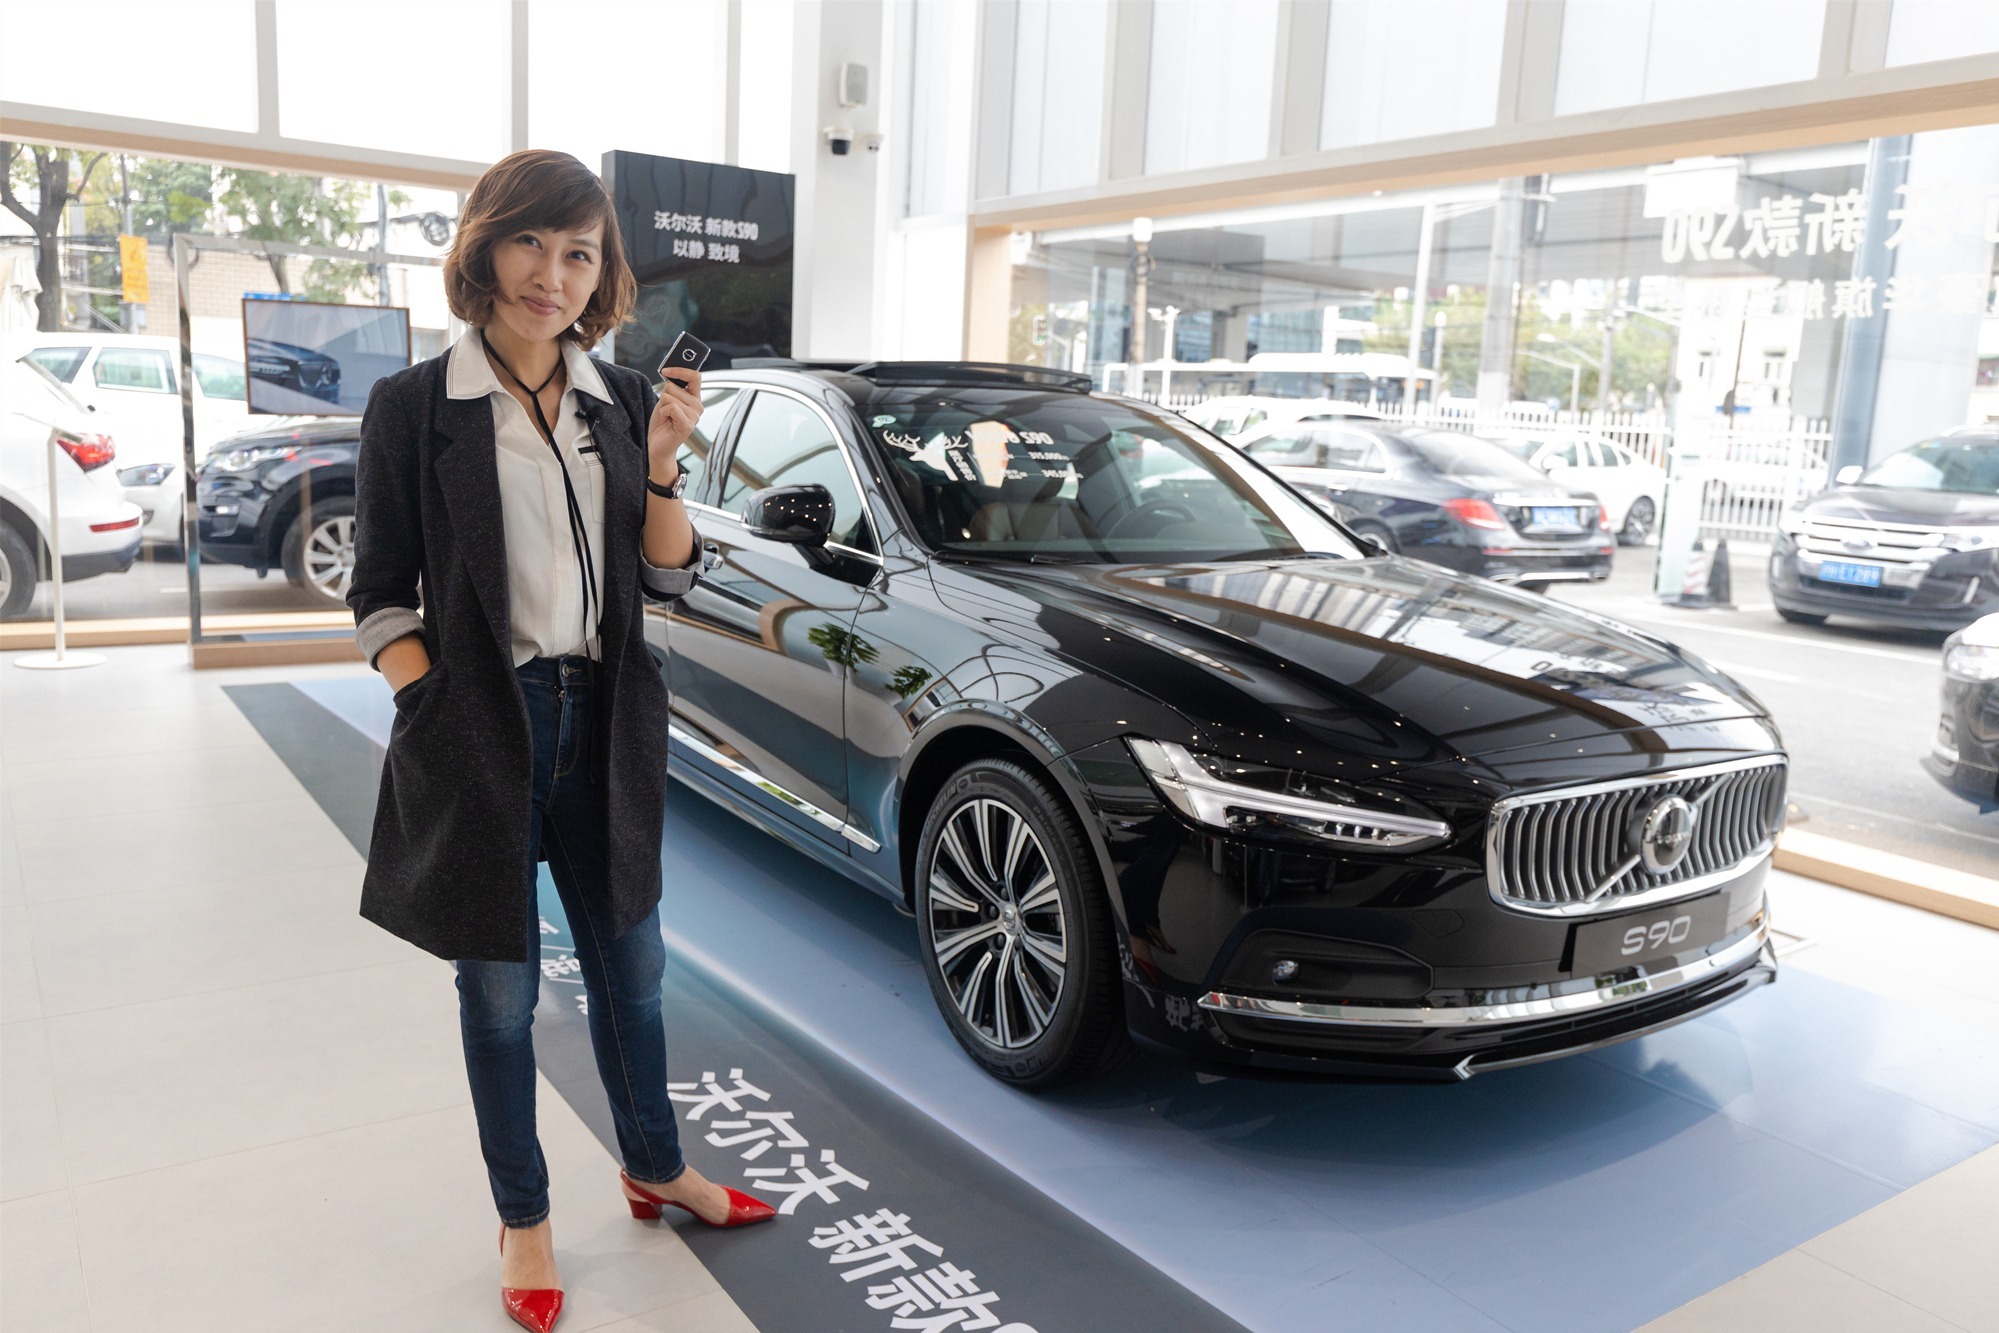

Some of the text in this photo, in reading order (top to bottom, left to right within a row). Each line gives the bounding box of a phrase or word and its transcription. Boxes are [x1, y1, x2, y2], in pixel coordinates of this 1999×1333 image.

[654, 210, 759, 241] 沃尔沃 新款S90
[1620, 915, 1691, 956] S90
[667, 1068, 1039, 1333] 沃尔沃 新款
